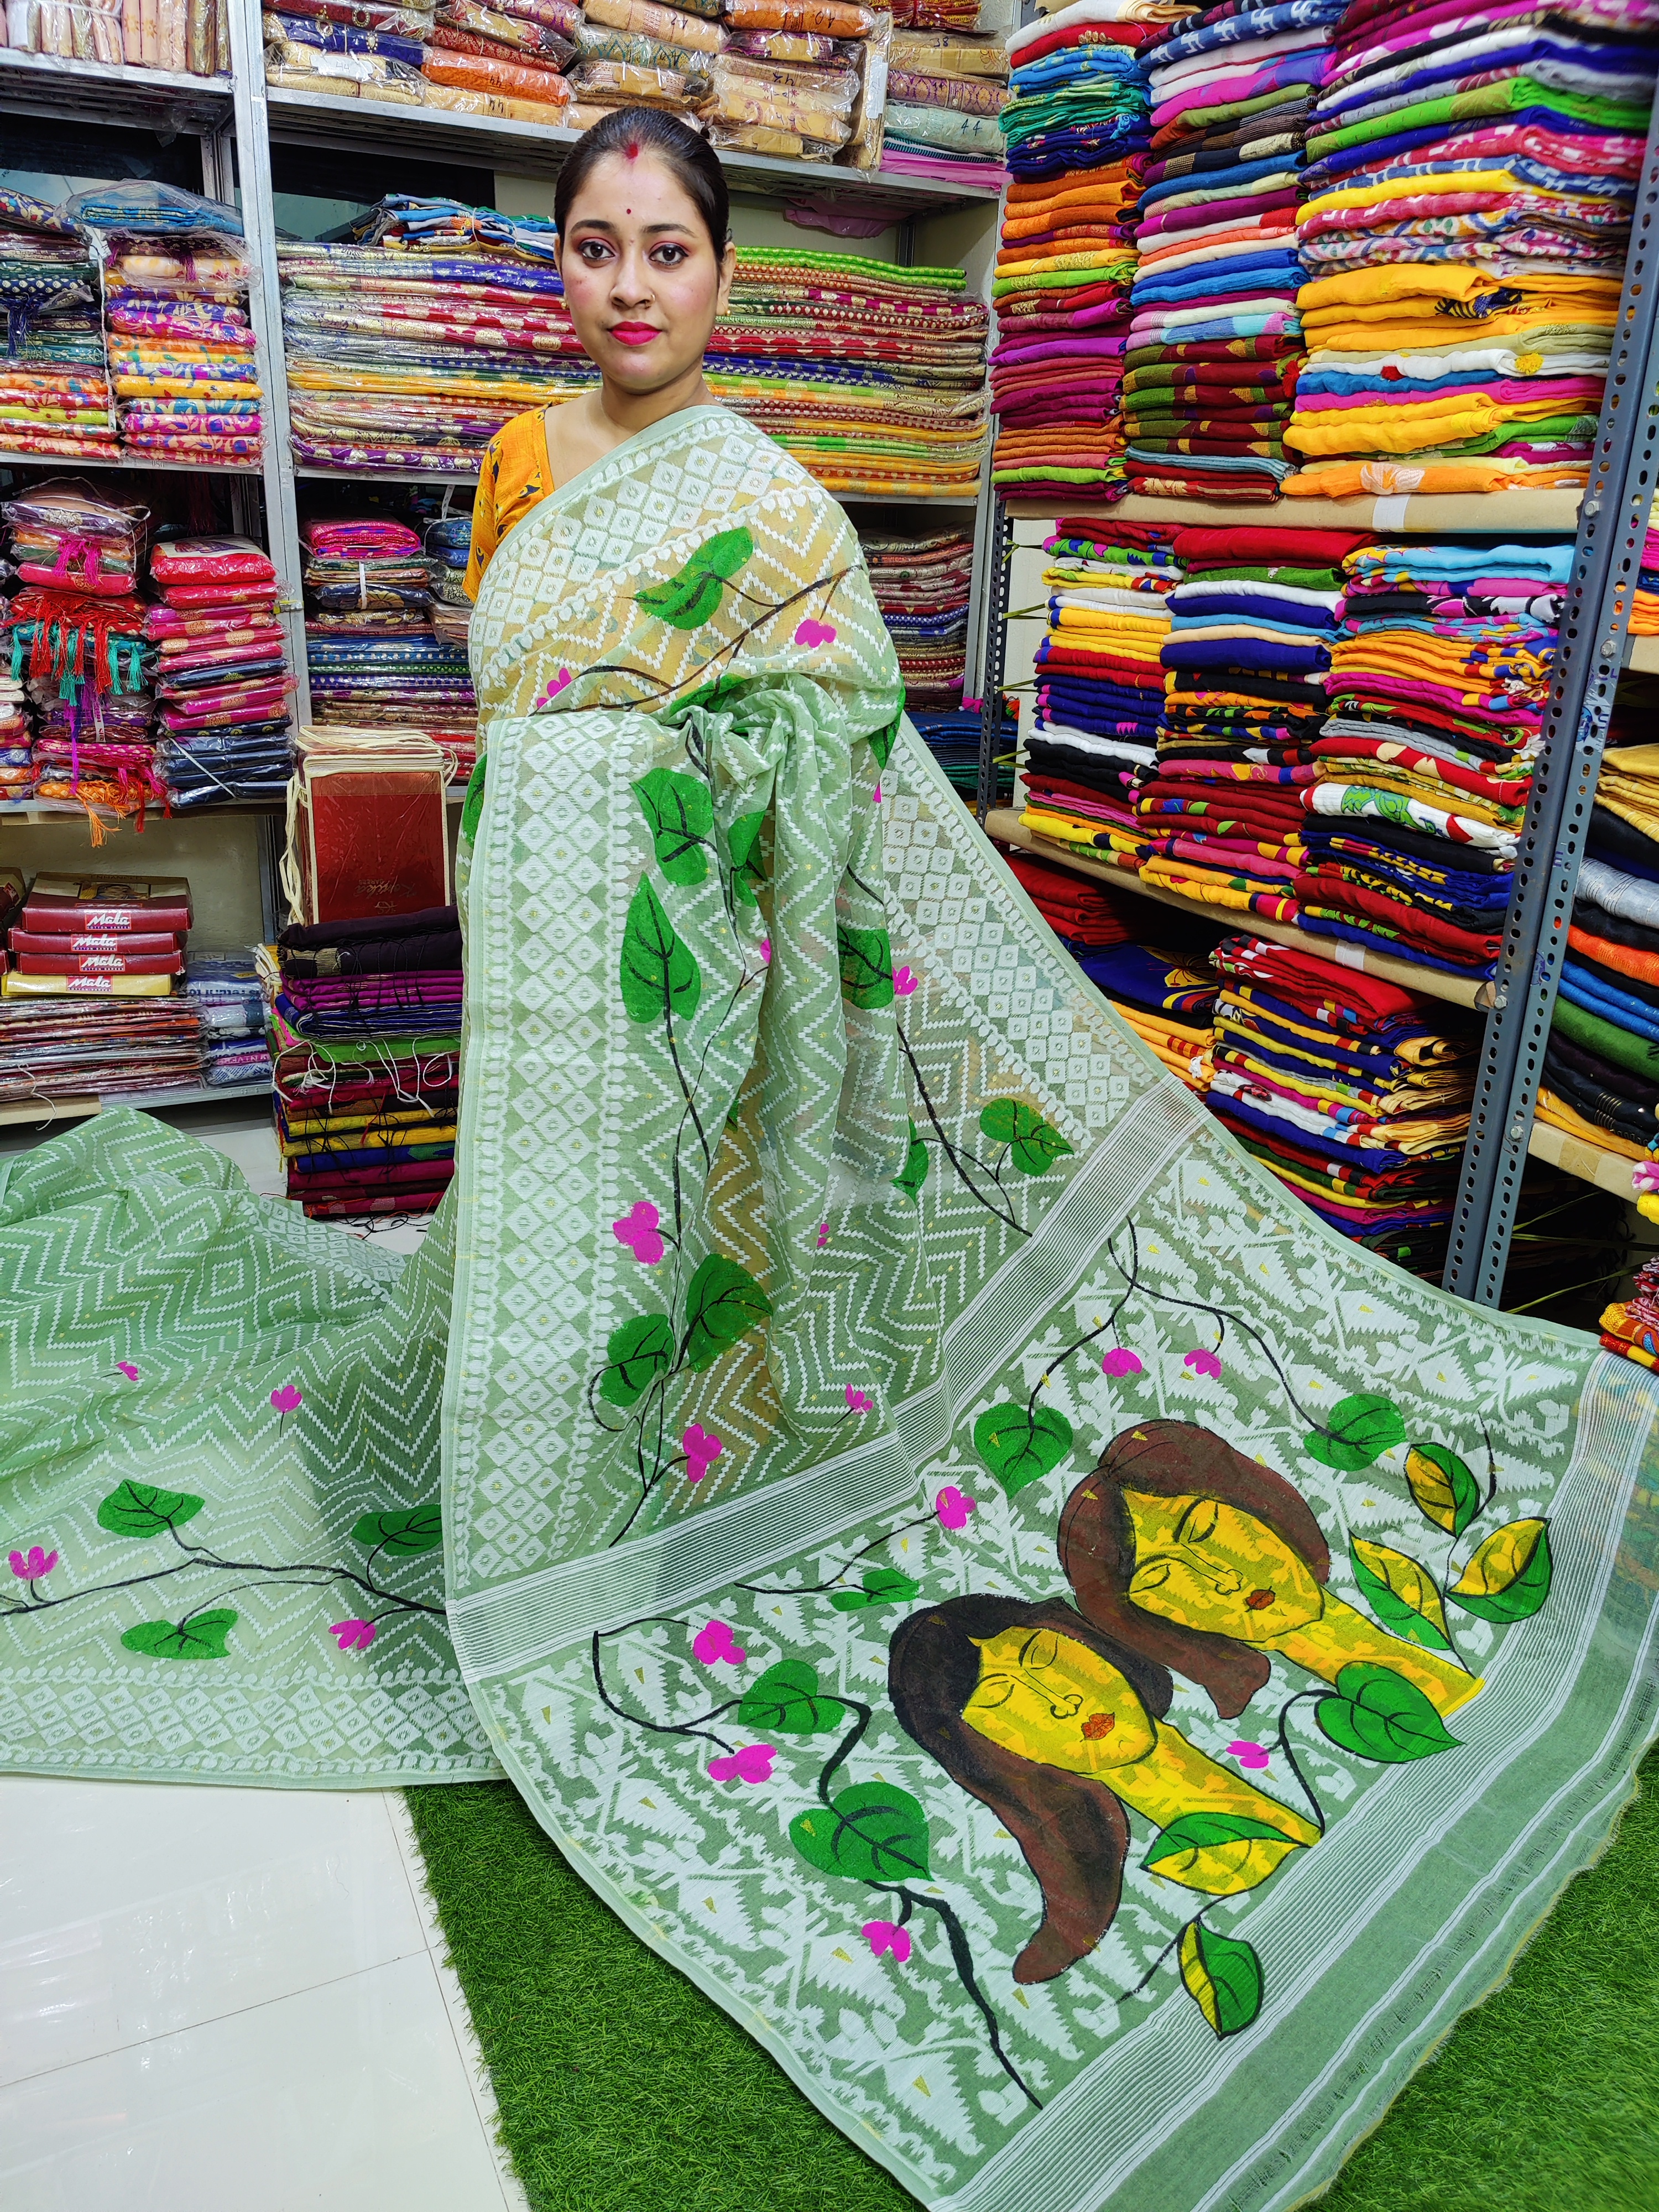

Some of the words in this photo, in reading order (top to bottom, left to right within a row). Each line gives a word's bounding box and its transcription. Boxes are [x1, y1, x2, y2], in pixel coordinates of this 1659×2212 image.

[930, 36, 949, 47] 38
[336, 61, 349, 72] 44
[961, 118, 982, 136] 44
[87, 912, 131, 926] Mala
[72, 933, 117, 947] Mala
[81, 954, 124, 967] Mala
[67, 975, 111, 987] Mala
